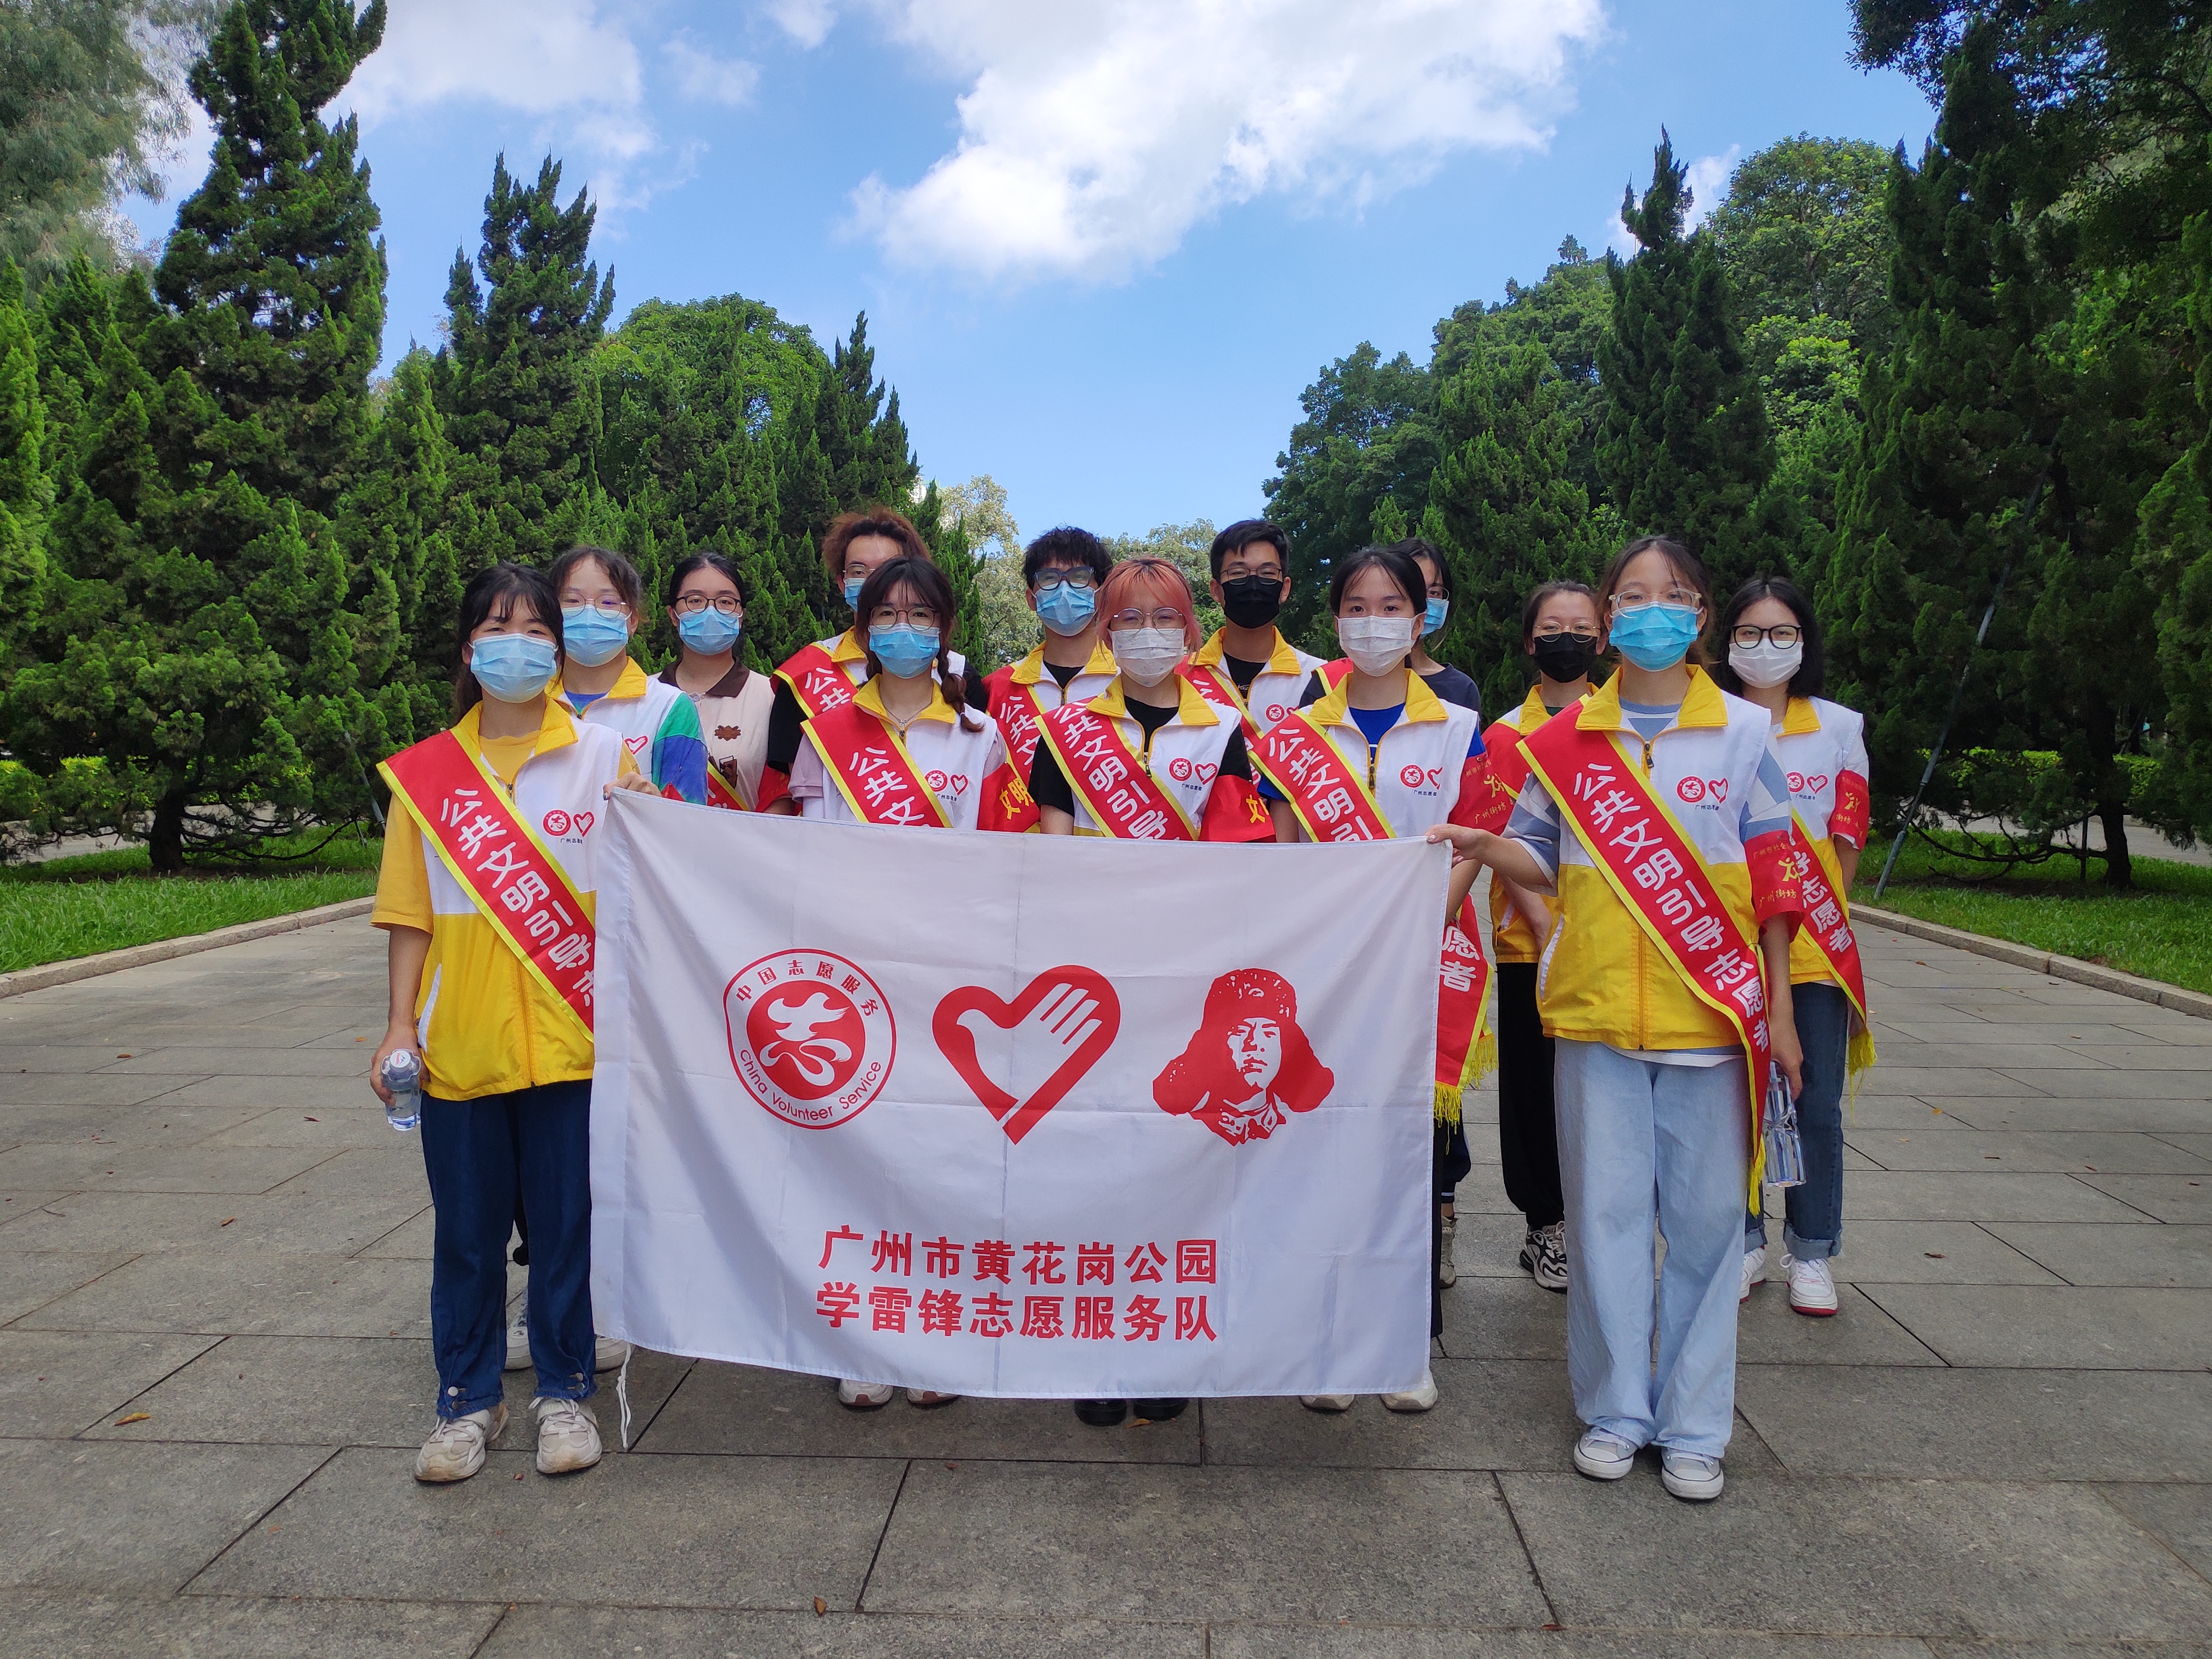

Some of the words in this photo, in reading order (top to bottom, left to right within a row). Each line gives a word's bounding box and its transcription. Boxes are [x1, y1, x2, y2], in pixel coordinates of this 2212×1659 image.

[805, 667, 851, 712] 公共
[1246, 794, 1269, 823] 文
[1574, 763, 1768, 1052] 公共文明引导志愿者
[1440, 919, 1480, 992] 愿者
[736, 960, 879, 1017] 中国志愿服务
[740, 1049, 768, 1094] China
[772, 1092, 833, 1121] Volunteer
[839, 1061, 882, 1109] Service
[818, 1225, 1217, 1286] 广州市黄花岗公园
[816, 1282, 1217, 1342] 学雷锋志愿服务队
